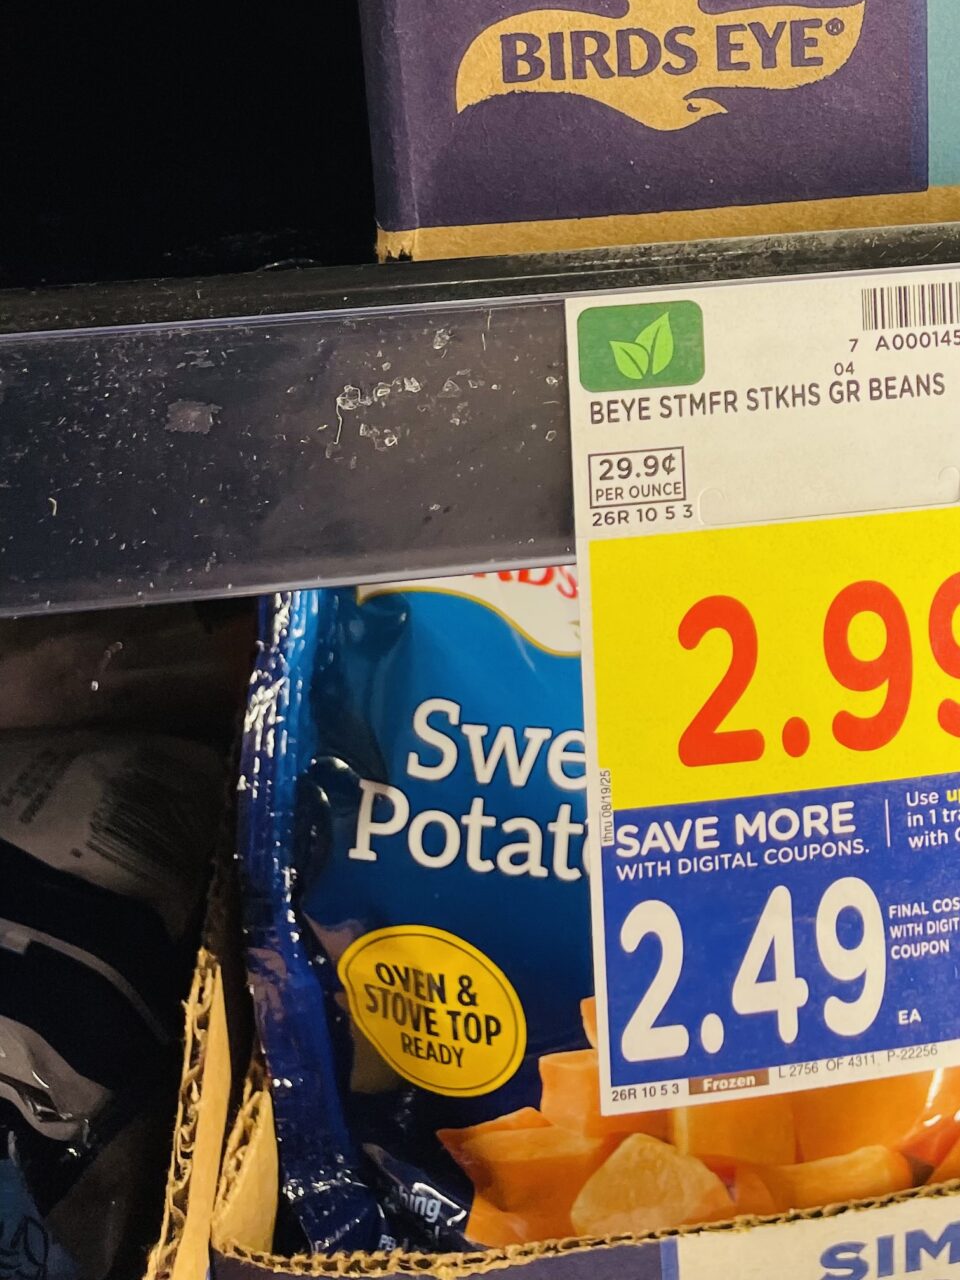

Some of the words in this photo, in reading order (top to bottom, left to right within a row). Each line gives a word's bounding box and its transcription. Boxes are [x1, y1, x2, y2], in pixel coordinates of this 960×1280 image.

[500, 26, 698, 84] BIRDS
[848, 338, 859, 353] 7
[833, 361, 855, 376] 04
[590, 397, 651, 424] BEYE
[659, 390, 738, 419] STMFR
[746, 382, 820, 412] STKHS
[829, 378, 861, 404] GR
[869, 371, 945, 401] BEANS
[599, 453, 676, 481] 29.9¢
[595, 487, 624, 503] PER
[629, 481, 682, 499] OUNCE
[592, 509, 630, 527] 26R
[636, 507, 657, 523] 10
[665, 505, 675, 520] 5
[683, 503, 693, 518] 3
[600, 770, 613, 818] 08/19/25
[905, 790, 940, 807] Use
[348, 778, 592, 880] Potat
[616, 816, 720, 858] SAVE
[735, 801, 856, 846] MORE
[906, 812, 924, 828] in
[929, 808, 937, 825] 1
[603, 821, 614, 843] thru
[908, 829, 948, 849] with
[616, 860, 671, 881] WITH
[678, 852, 757, 875] DIGITAL
[764, 838, 870, 866] COUPONS.
[888, 901, 929, 919] FINAL
[889, 923, 923, 940] WITH
[891, 939, 950, 960] COUPON
[619, 876, 886, 1062] 2.49
[375, 962, 447, 1004] OVEN
[457, 975, 478, 1006] &
[364, 983, 440, 1037] STOVE
[446, 1009, 502, 1046] TOP
[898, 1008, 922, 1025] EA
[401, 1032, 464, 1068] READY
[789, 1061, 819, 1076] 2756
[826, 1057, 843, 1071] OF
[887, 1045, 938, 1063] P-22256
[611, 1085, 637, 1102] 26R
[642, 1085, 657, 1098] 10
[661, 1084, 668, 1096] 5
[672, 1082, 679, 1094] 3
[703, 1074, 756, 1092] Frozen
